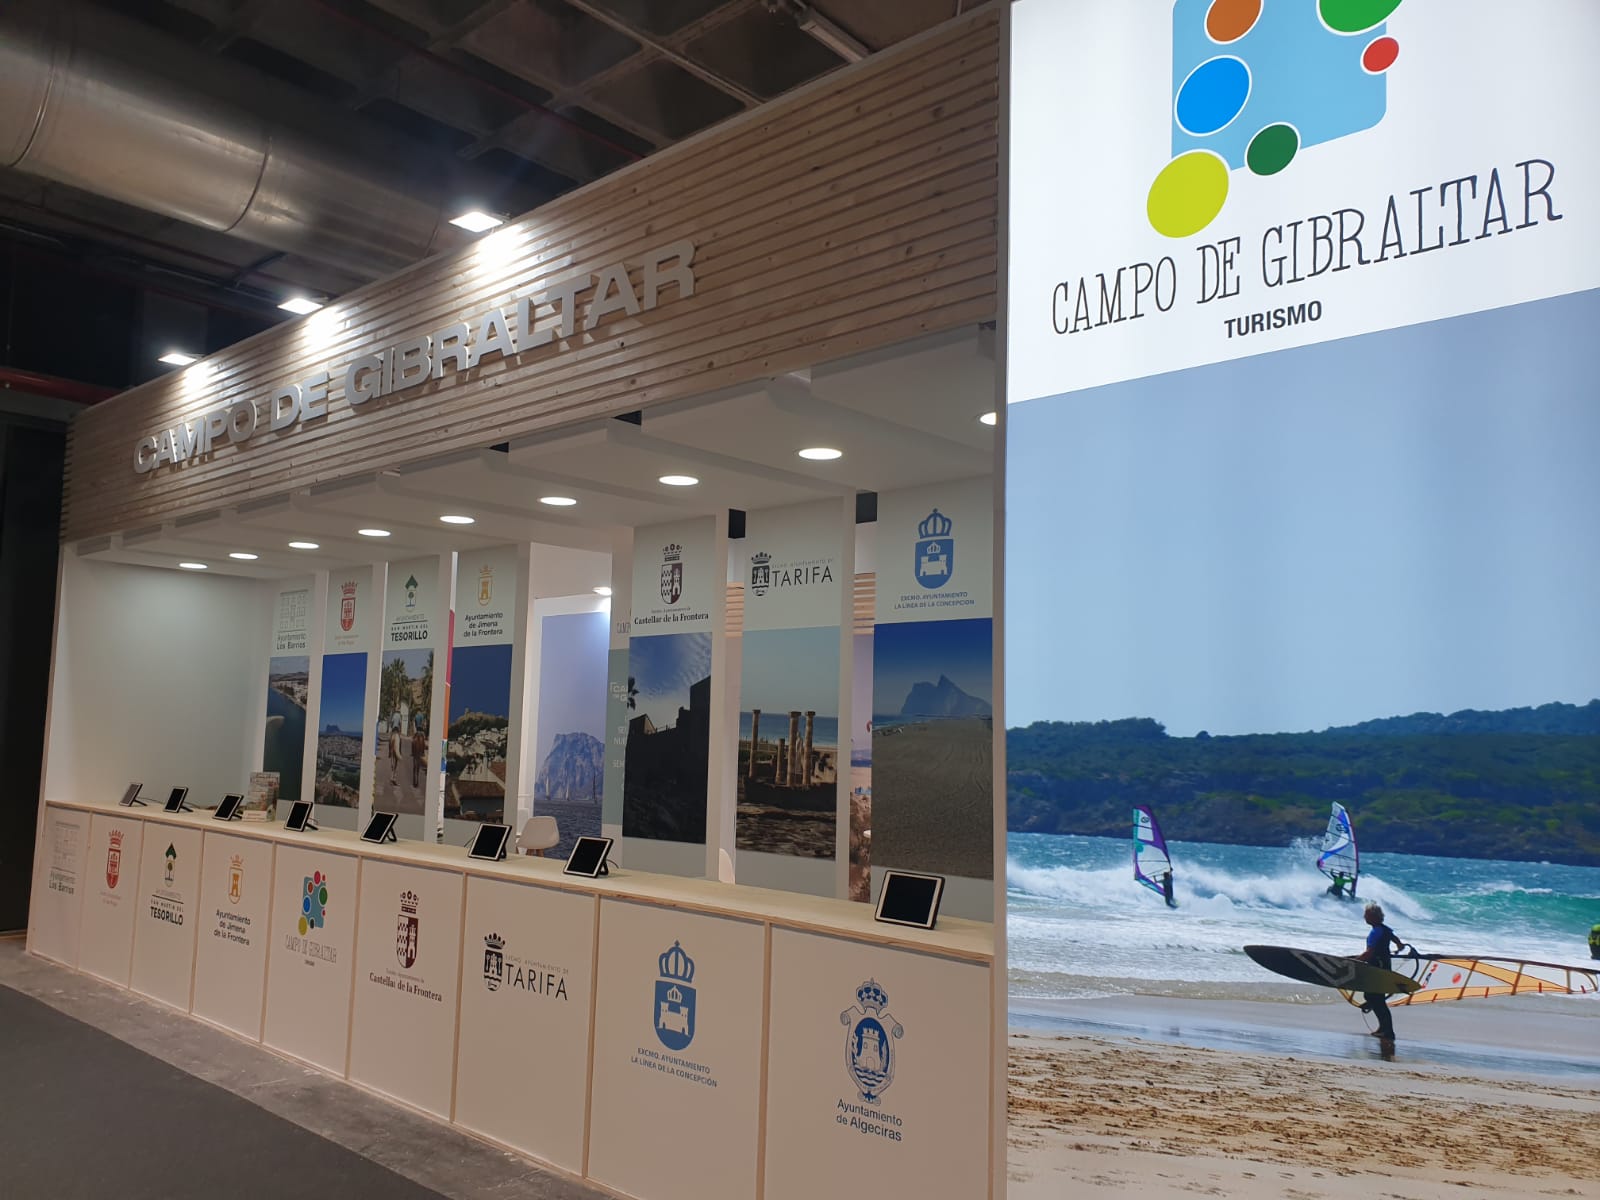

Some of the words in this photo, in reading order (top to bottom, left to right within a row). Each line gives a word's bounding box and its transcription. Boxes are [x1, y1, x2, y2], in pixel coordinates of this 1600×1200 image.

[1052, 256, 1177, 334] CAMPO
[1196, 236, 1242, 304] DE
[1261, 158, 1563, 287] GIBRALTAR
[1224, 300, 1323, 339] TURISMO
[132, 398, 259, 475] CAMPO
[269, 371, 331, 434] DE
[343, 239, 697, 406] GIBRALTAR
[771, 565, 833, 588] TARIFA
[922, 591, 968, 600] AYUNTAMIENTO
[465, 612, 503, 623] Ayuntamiento
[477, 621, 498, 629] Jimena
[634, 616, 662, 625] Castellar
[663, 614, 671, 623] de
[672, 613, 679, 622] la
[680, 612, 709, 622] Frontera
[391, 630, 428, 642] TESORILLO
[478, 628, 503, 636] Frontera
[150, 905, 184, 925] TESORILLO
[216, 909, 251, 926] Ayuntamiento
[219, 920, 226, 929] de
[227, 922, 246, 934] Jimena
[213, 929, 221, 937] de
[222, 930, 227, 939] la
[227, 931, 250, 946] Frontera
[369, 972, 396, 988] Castellar
[397, 980, 406, 991] de
[406, 981, 413, 993] la
[413, 984, 442, 1002] Frontera
[505, 963, 568, 1000] TARIFA
[657, 1064, 666, 1072] DE
[667, 1066, 675, 1075] LA
[661, 1053, 711, 1074] AYUNTAMIENTO
[837, 1098, 903, 1127] Ayuntamiento
[836, 1114, 848, 1125] de
[850, 1116, 902, 1142] Algeciras
